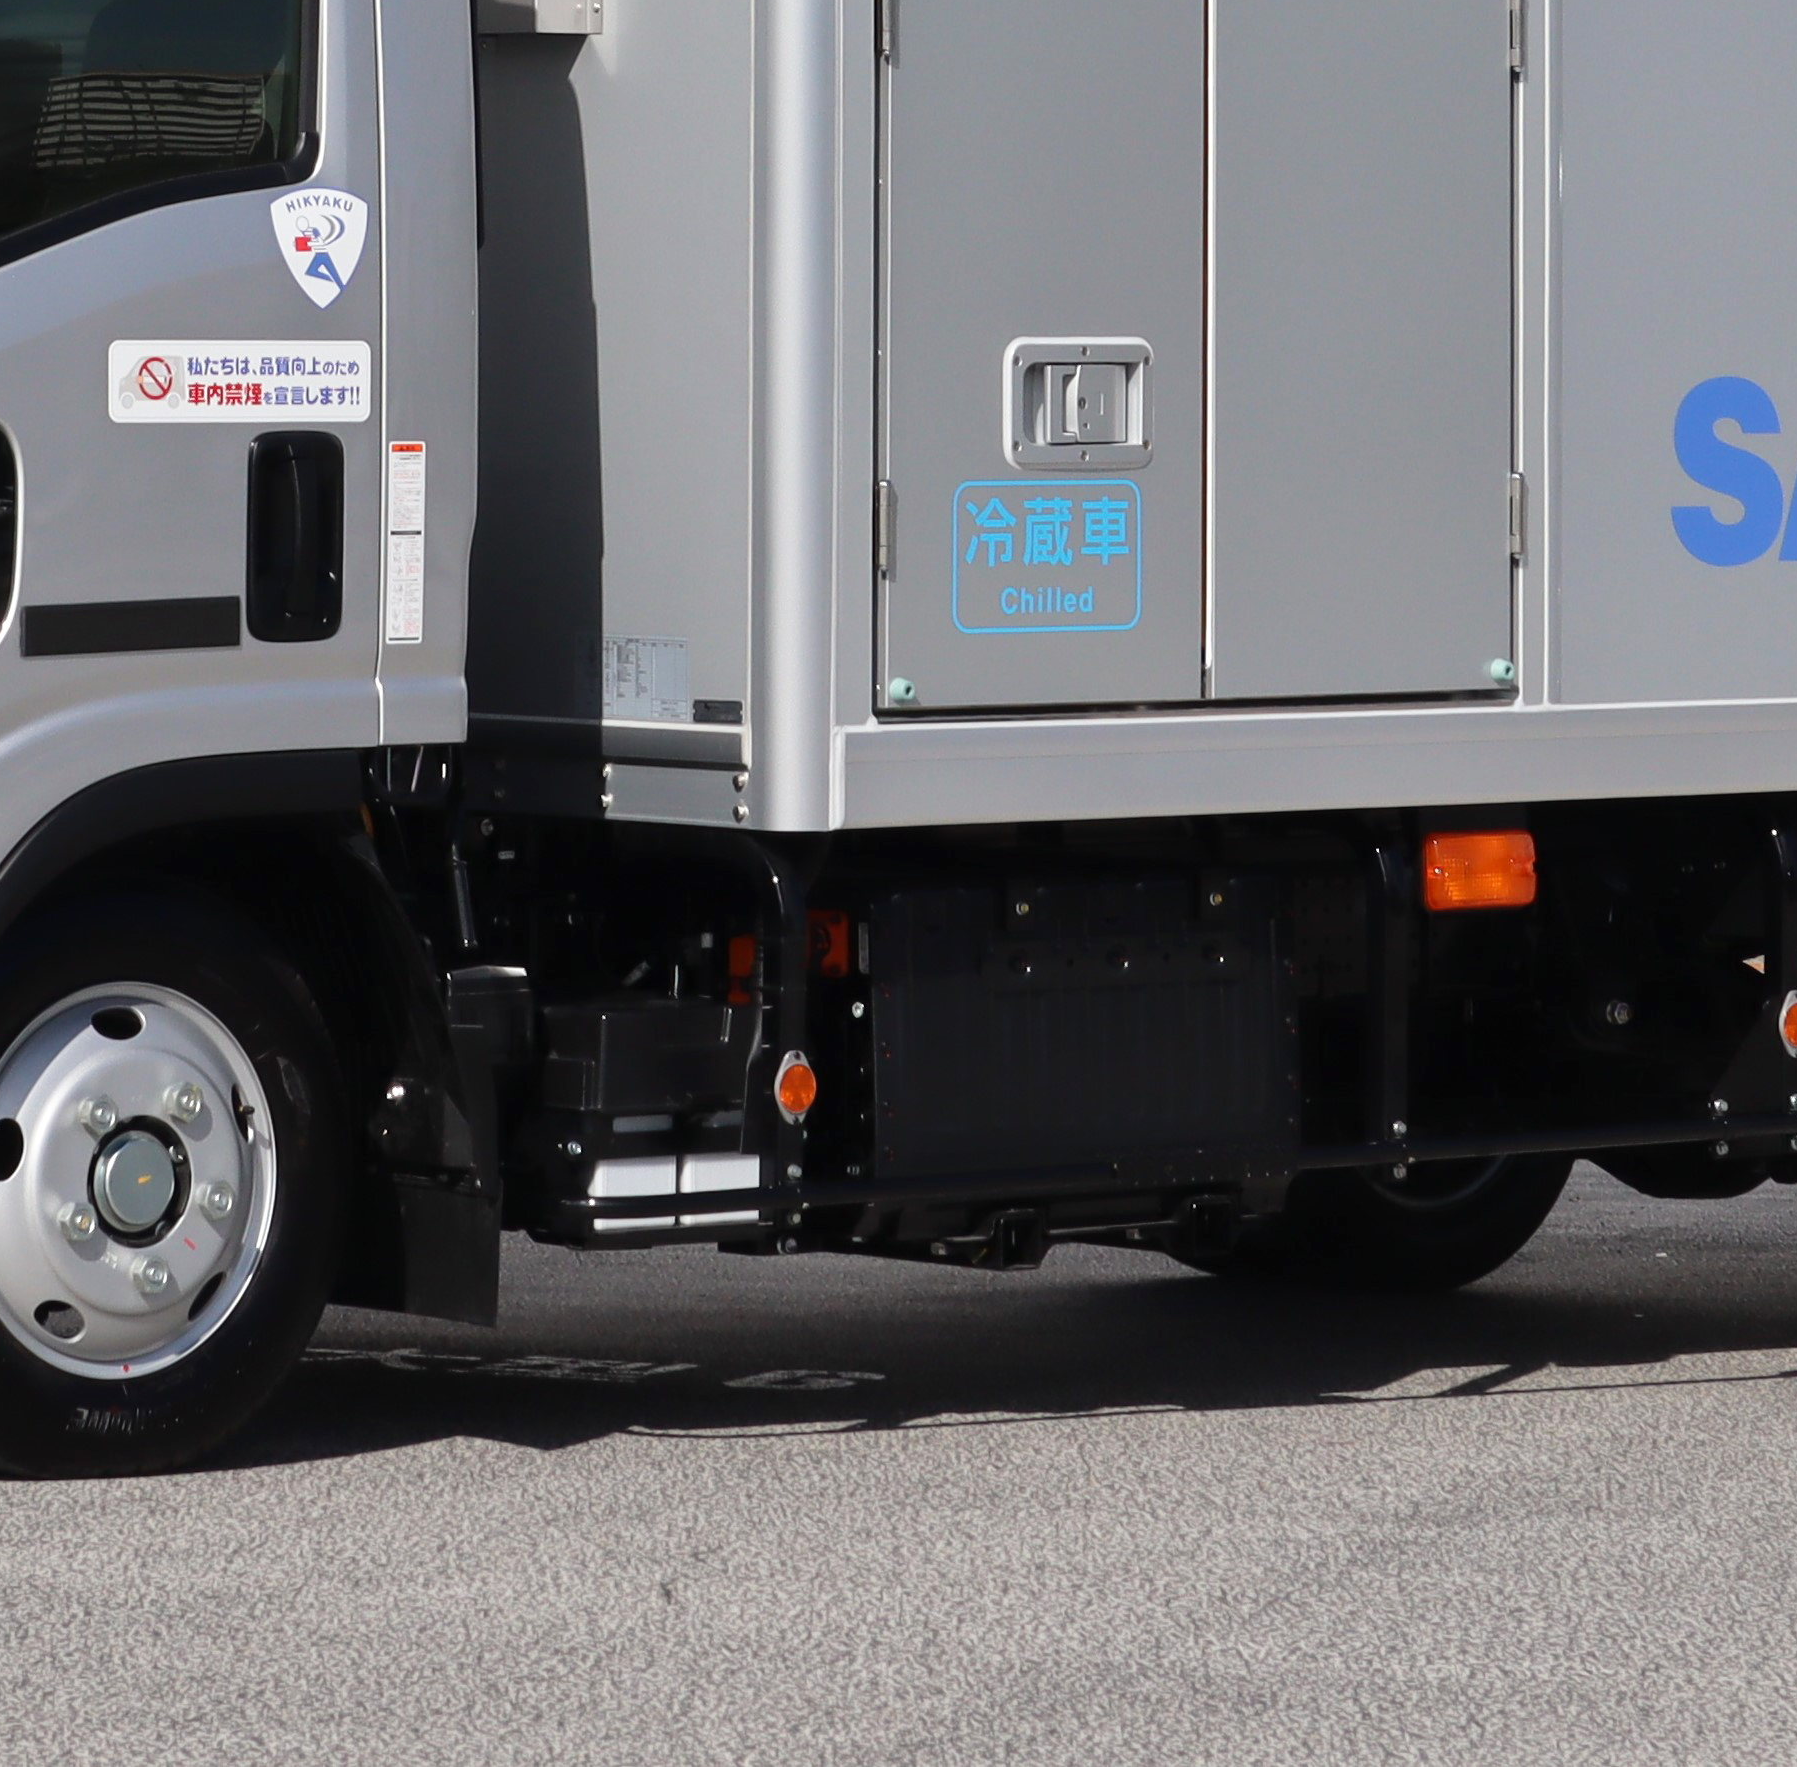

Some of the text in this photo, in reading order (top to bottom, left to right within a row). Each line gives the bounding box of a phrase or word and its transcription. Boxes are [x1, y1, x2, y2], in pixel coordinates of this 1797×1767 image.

[285, 195, 353, 213] HIKYAKU
[187, 356, 360, 376] 私たちは、品質向上のため
[964, 496, 1130, 567] 冷蔵車
[1000, 586, 1094, 615] Chilled
